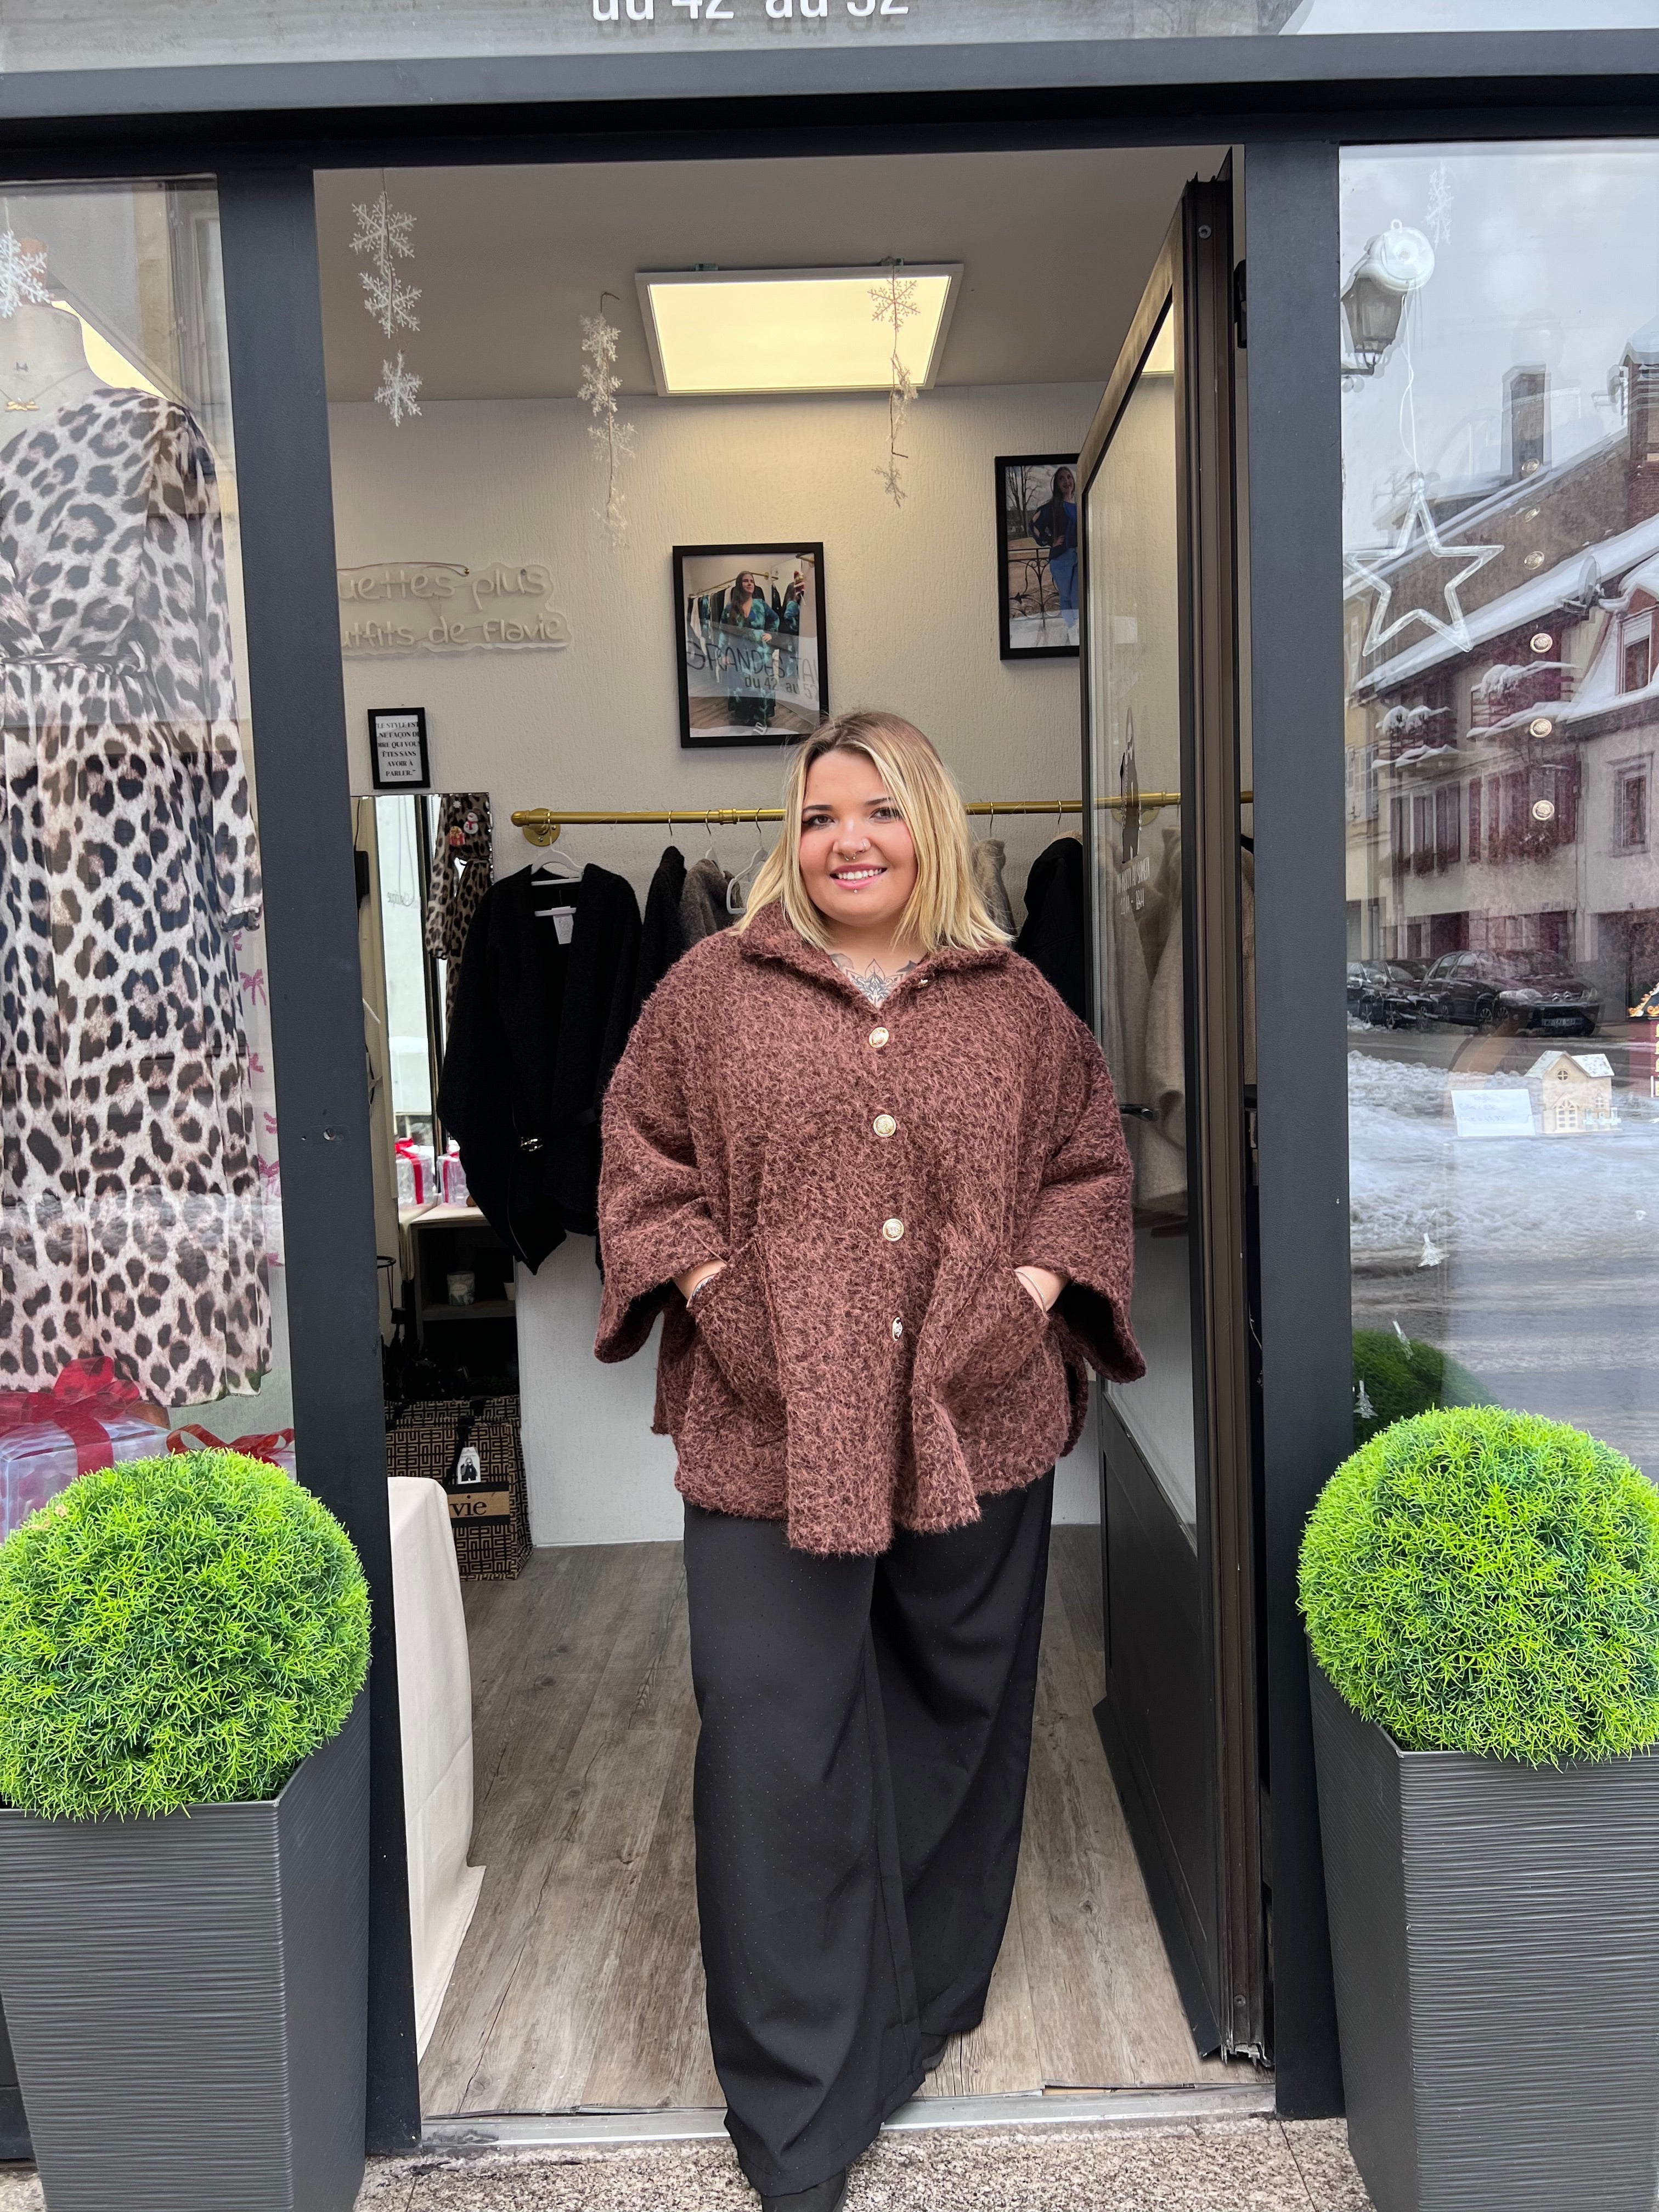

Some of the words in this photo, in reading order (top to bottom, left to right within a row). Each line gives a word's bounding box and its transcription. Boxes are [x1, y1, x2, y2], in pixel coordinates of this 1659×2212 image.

[472, 569, 546, 611] plus
[428, 616, 469, 645] de
[744, 676, 761, 689] du
[764, 678, 779, 691] 42
[786, 682, 800, 694] au
[449, 1494, 487, 1516] vie
